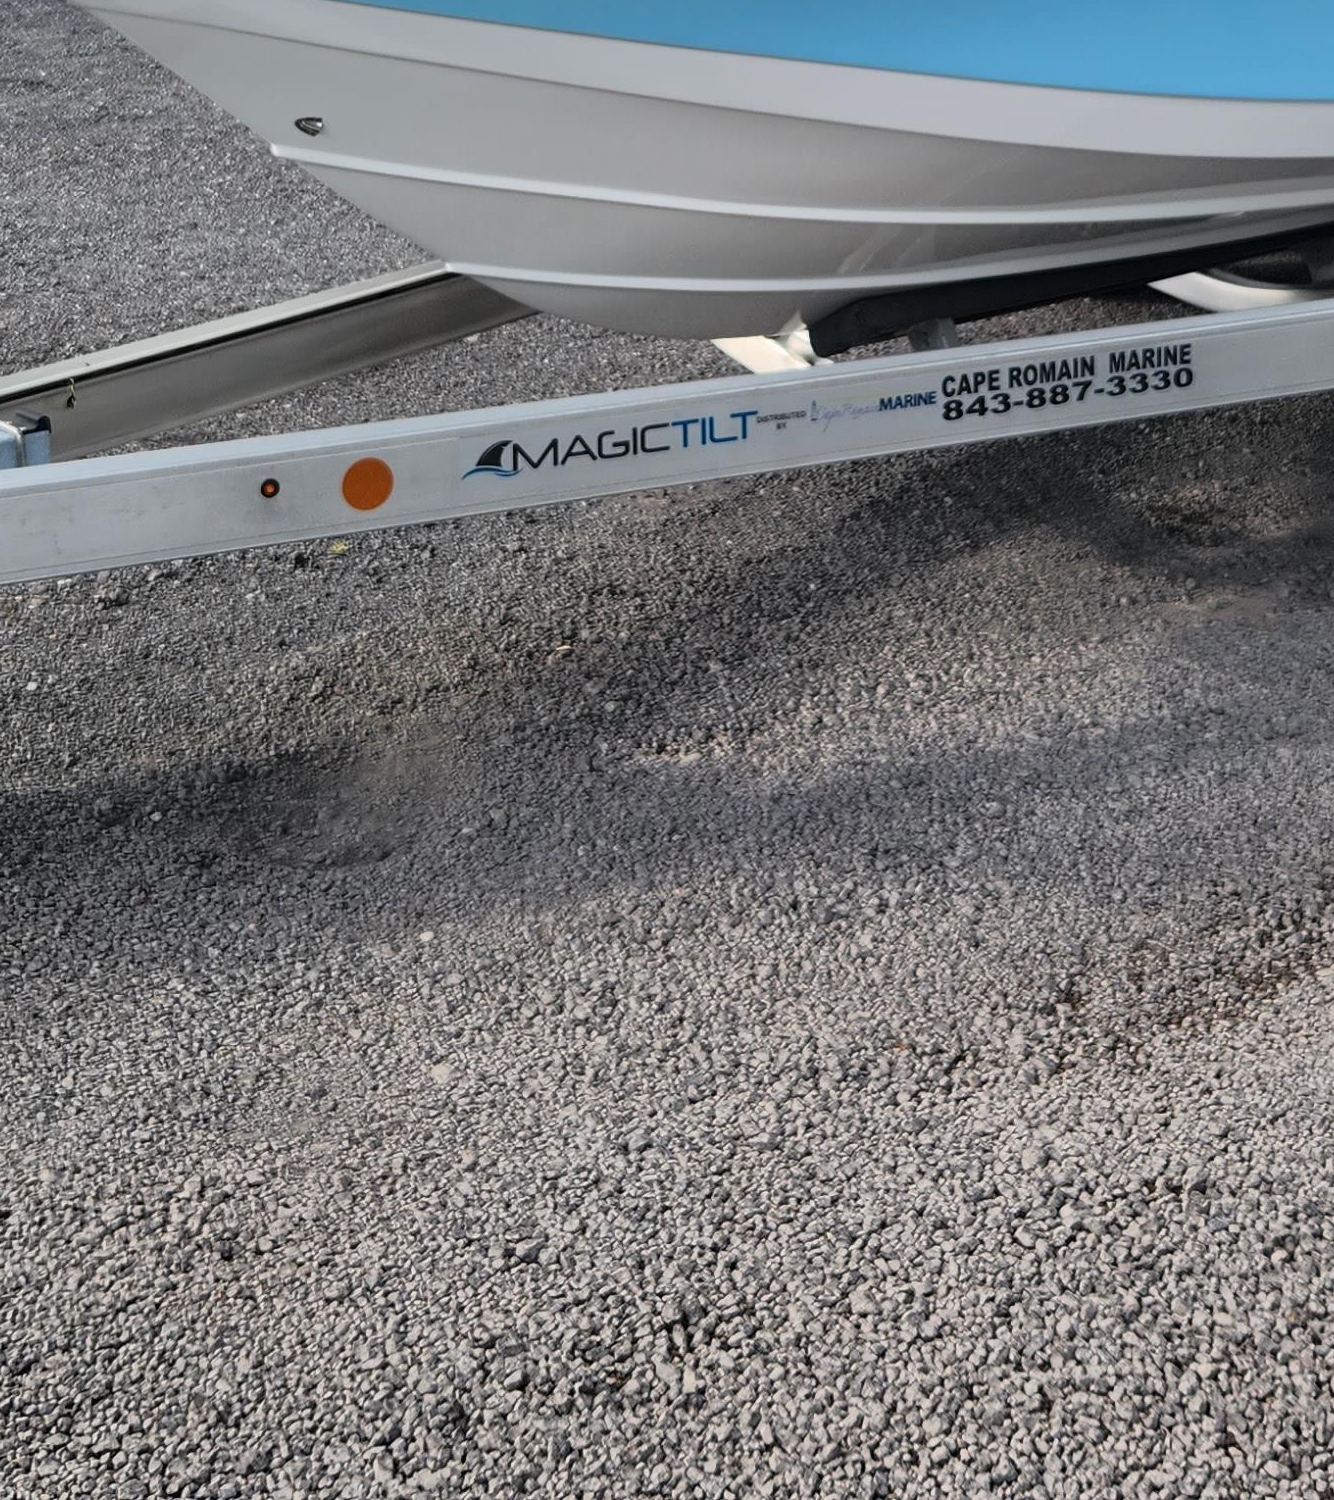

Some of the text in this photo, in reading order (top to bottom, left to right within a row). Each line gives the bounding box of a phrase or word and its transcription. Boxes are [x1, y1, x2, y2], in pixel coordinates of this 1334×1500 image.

[941, 343, 1193, 398] CAPE ROMAIN MARINE
[877, 390, 938, 412] MARINE
[941, 366, 1195, 422] 843-887-3330
[756, 410, 807, 424] DISTRIBUTED
